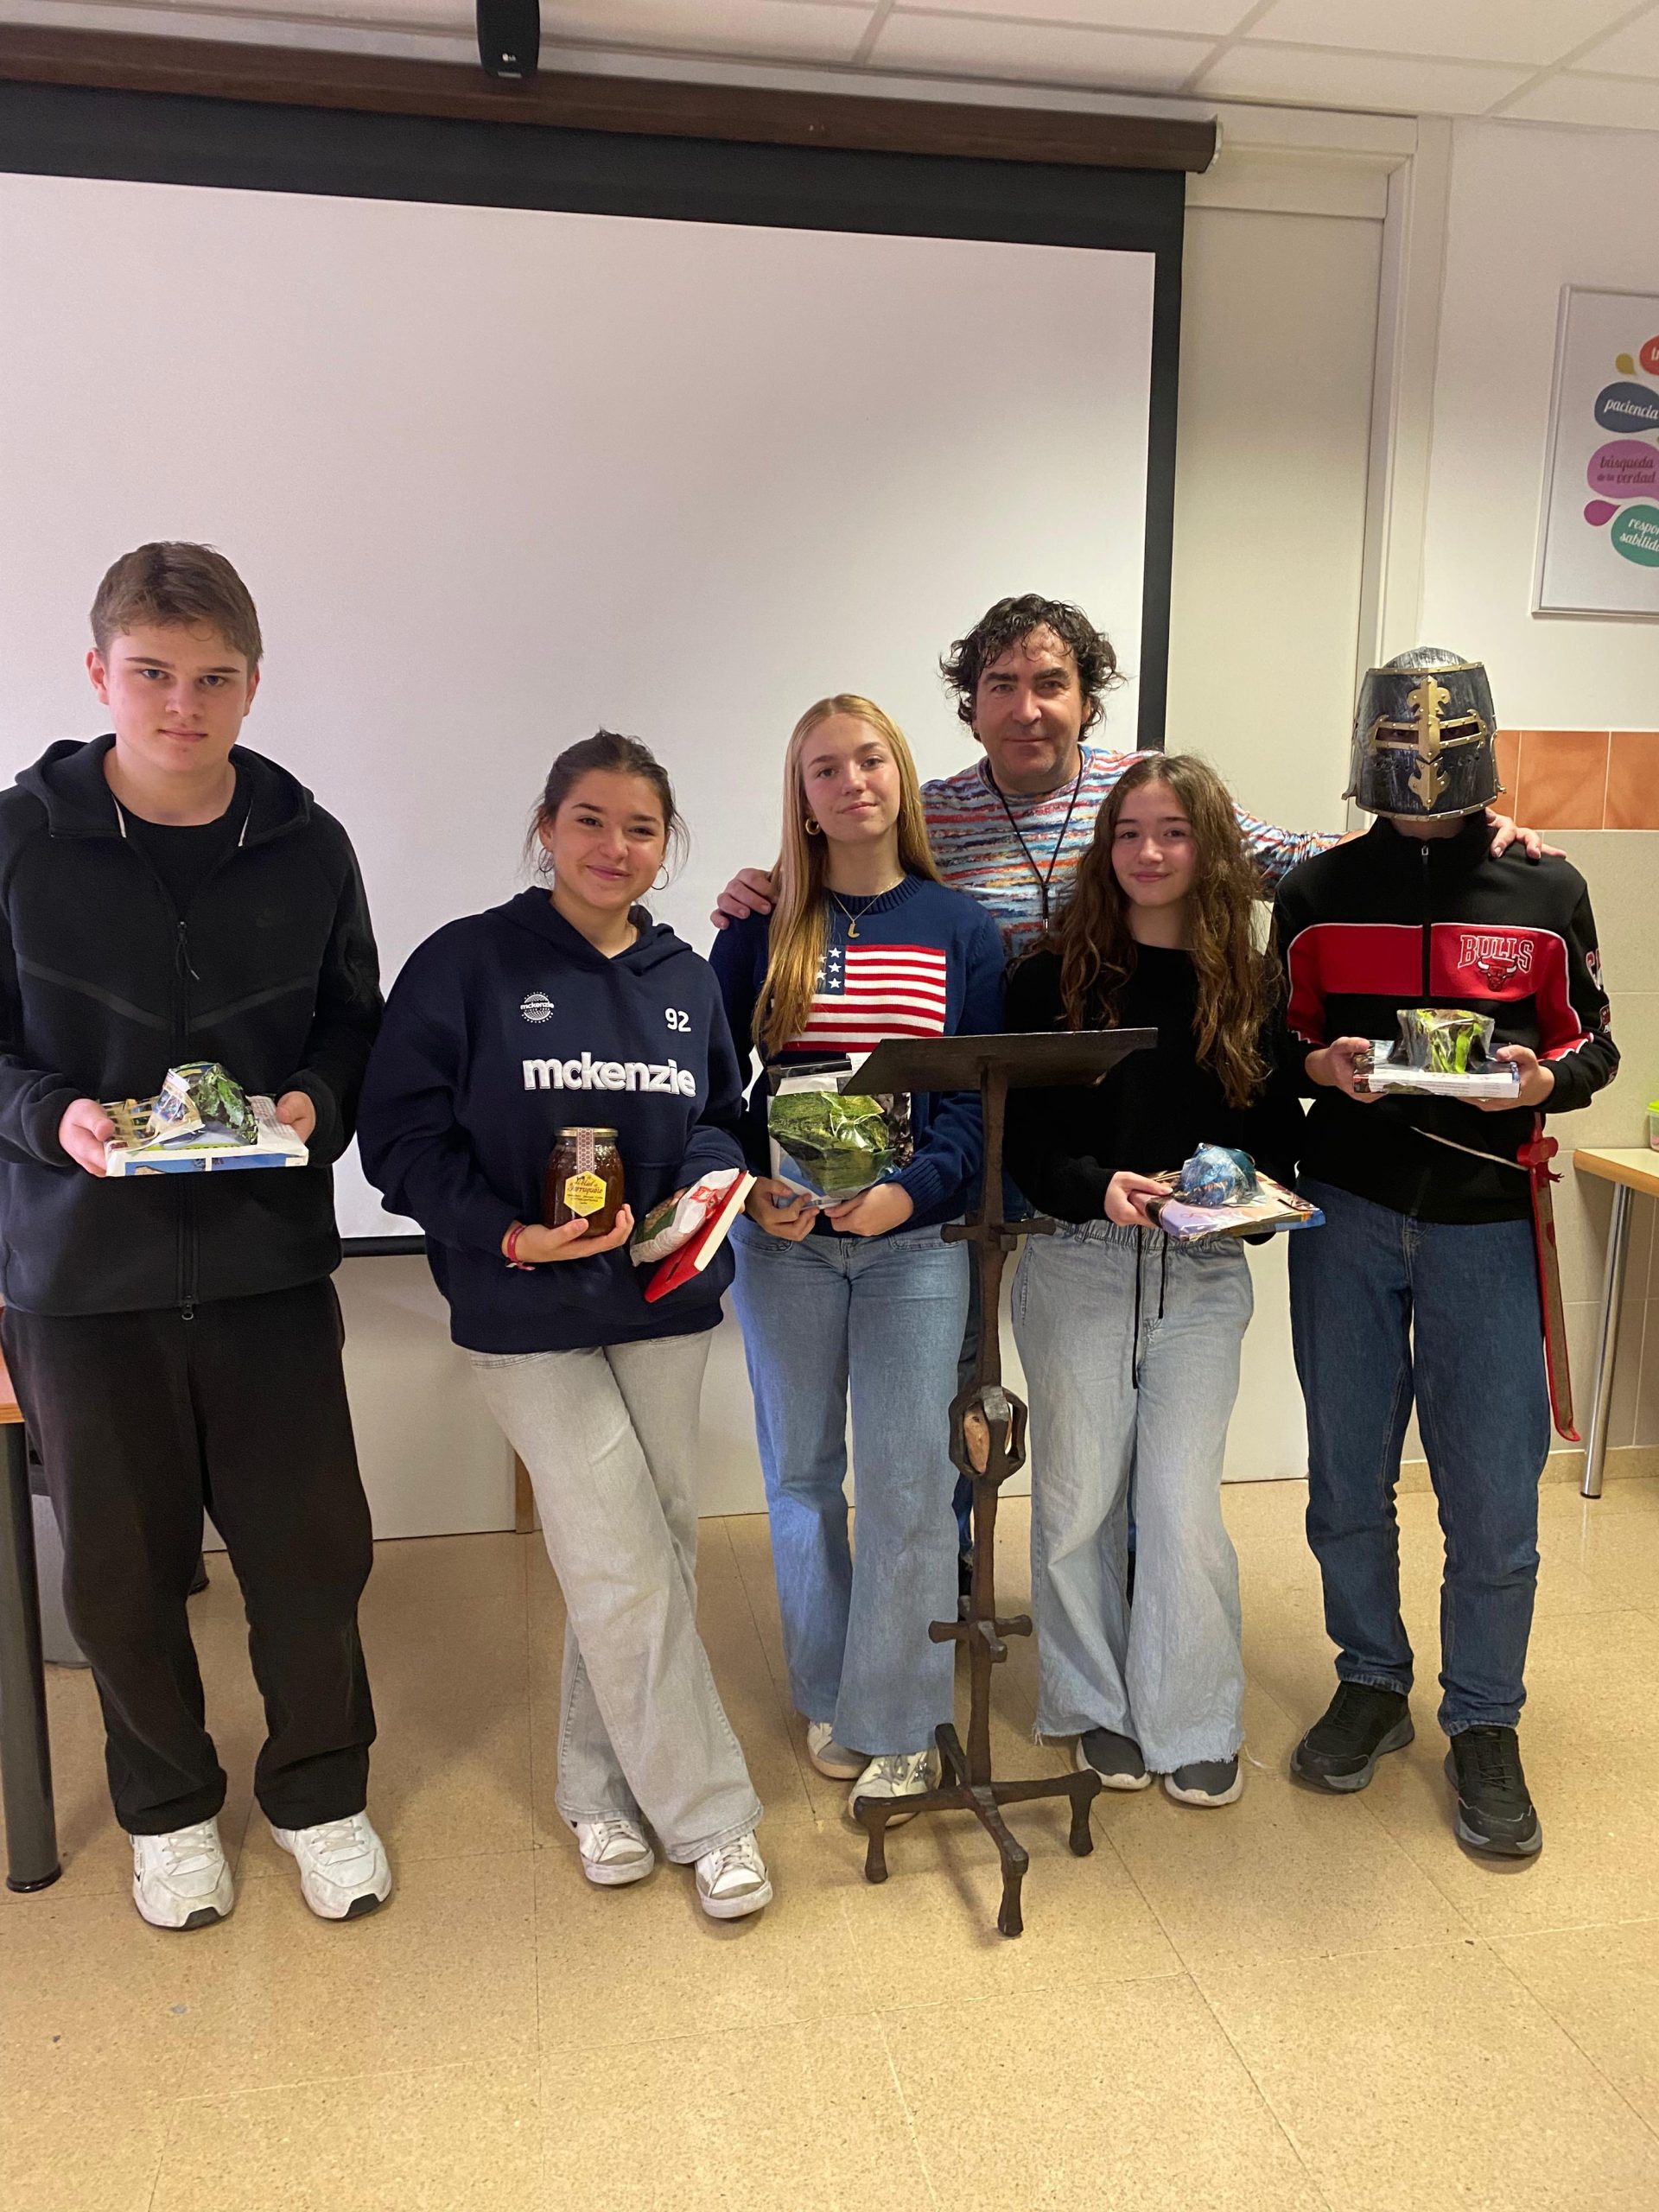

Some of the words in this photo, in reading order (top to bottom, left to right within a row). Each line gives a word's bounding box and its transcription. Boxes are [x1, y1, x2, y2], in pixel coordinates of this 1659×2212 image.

[1603, 398, 1659, 420] paciencia
[1457, 934, 1535, 974] BULLS
[664, 1007, 692, 1032] 92
[522, 1052, 696, 1097] mckenzie
